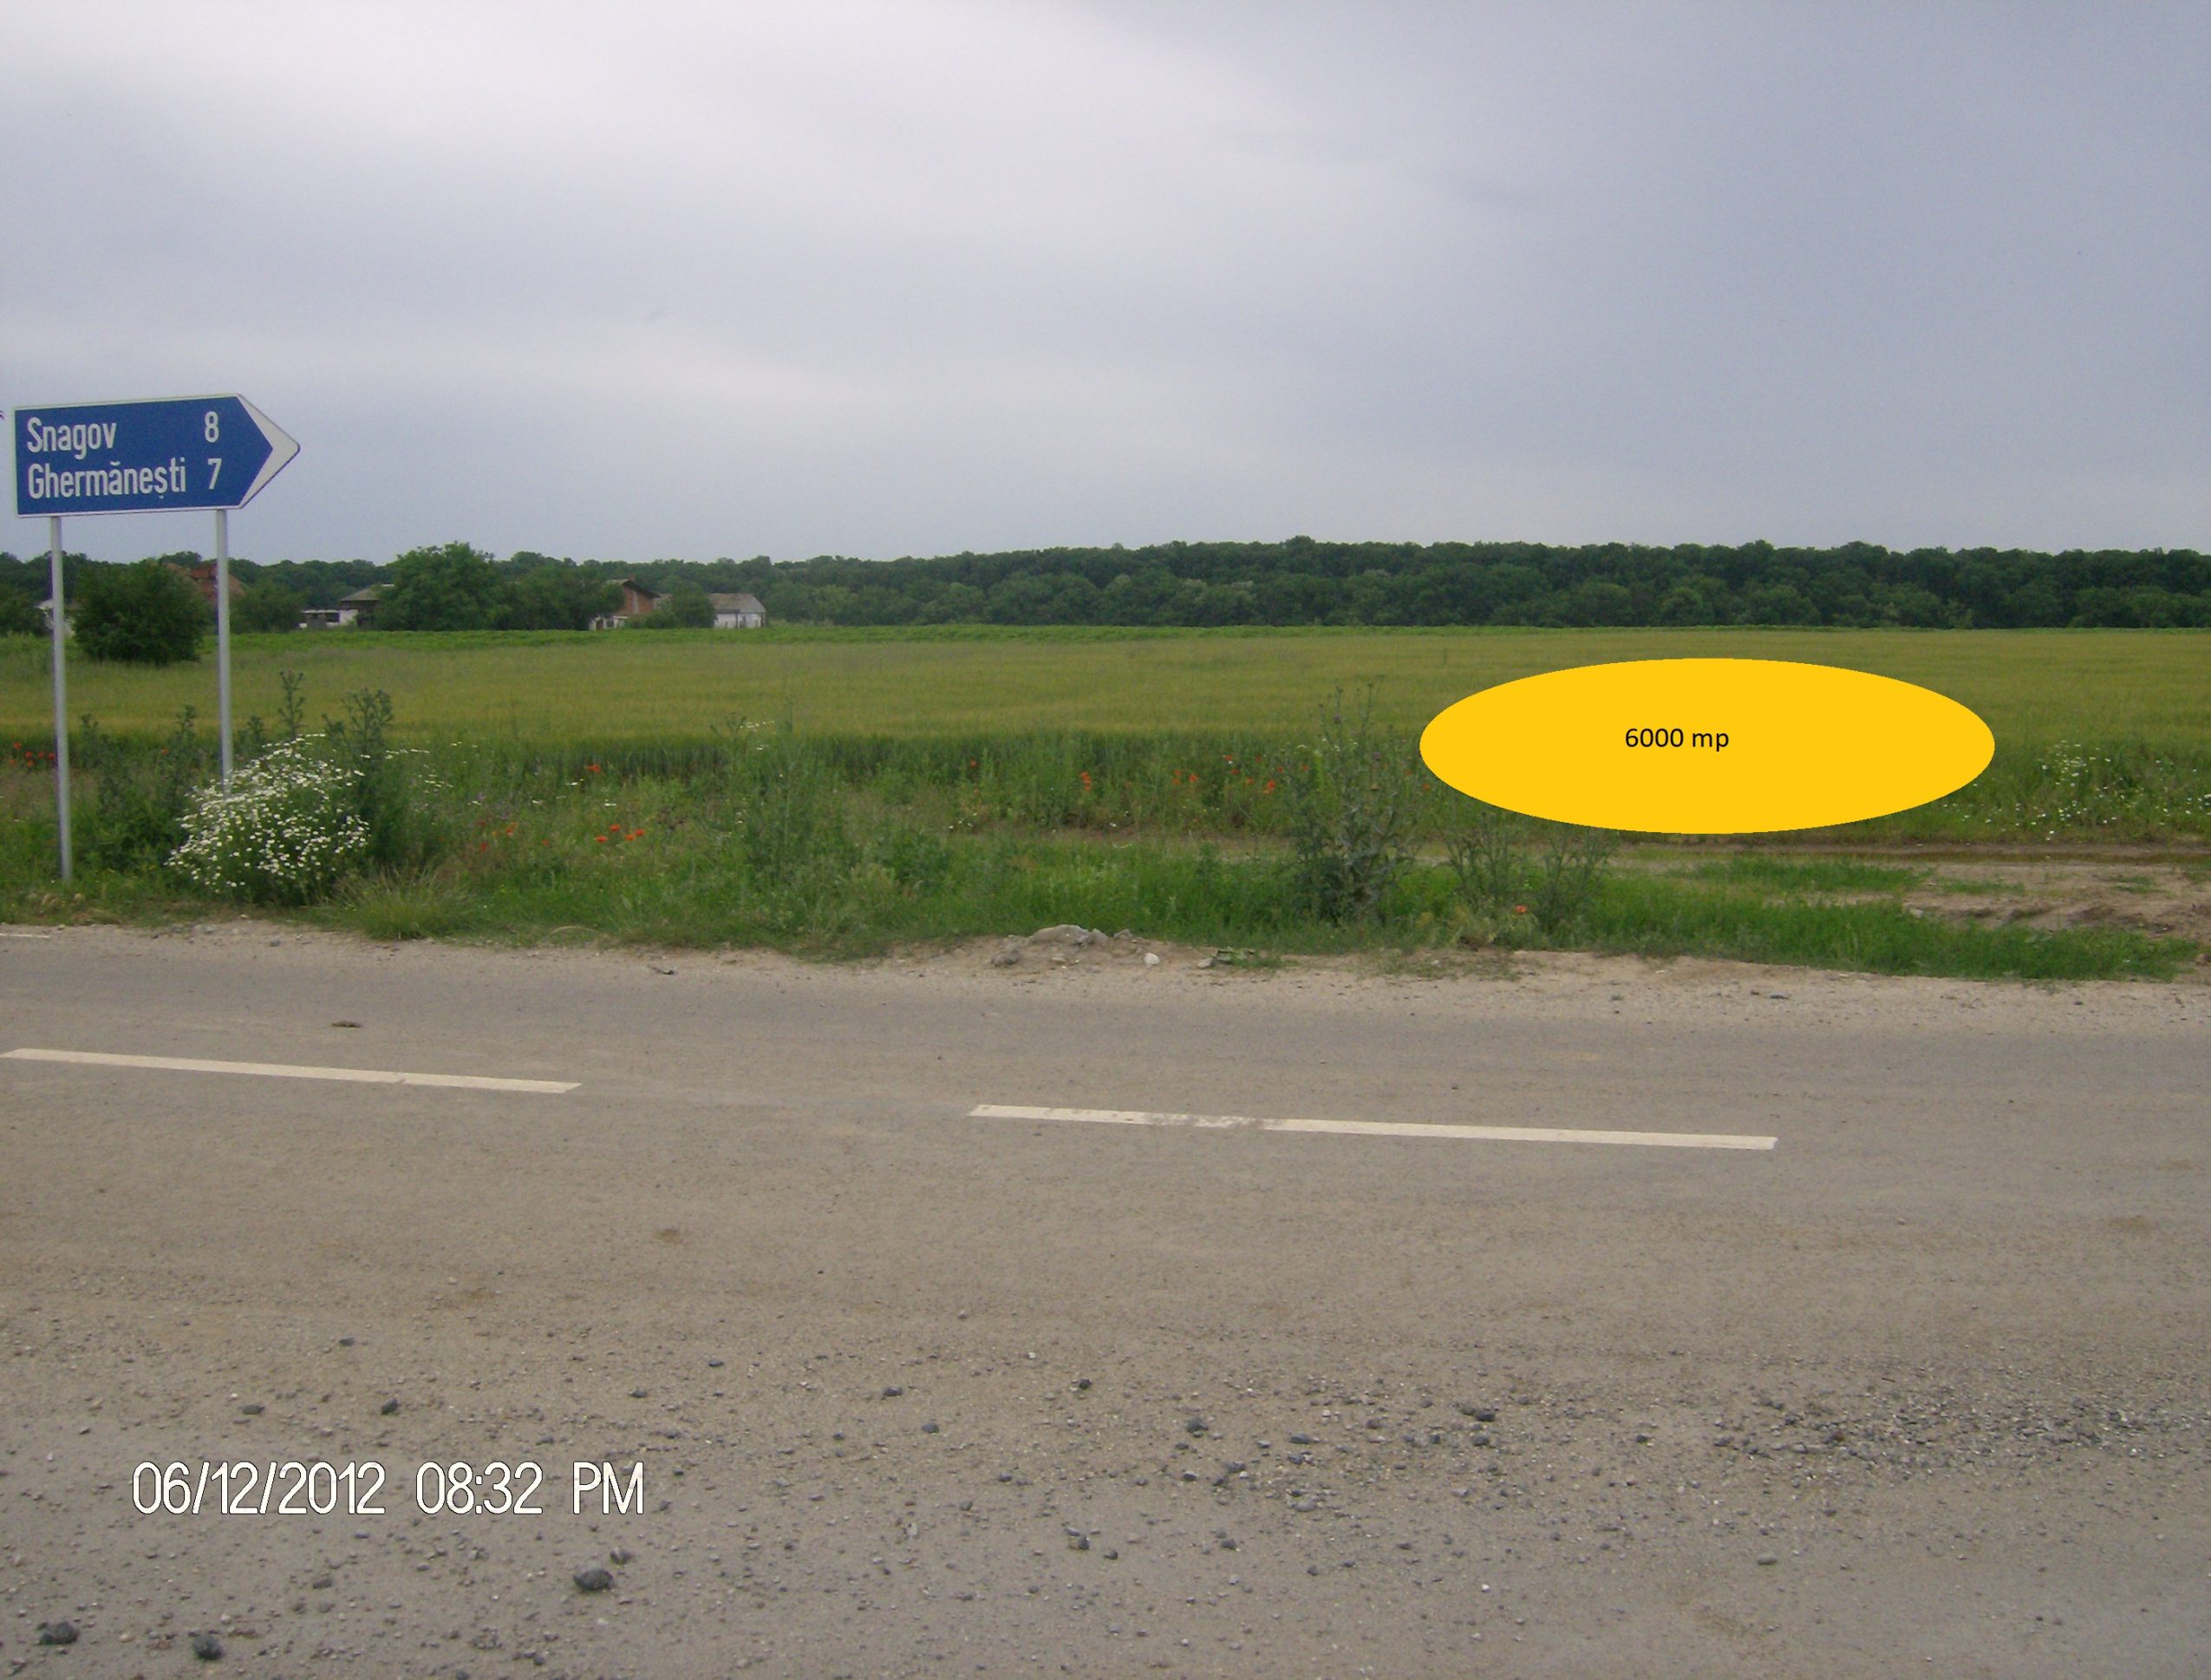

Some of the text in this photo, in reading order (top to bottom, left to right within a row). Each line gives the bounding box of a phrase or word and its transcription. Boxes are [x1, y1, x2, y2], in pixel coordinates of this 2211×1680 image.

[27, 411, 219, 459] Snagov 8
[207, 458, 222, 490] 7
